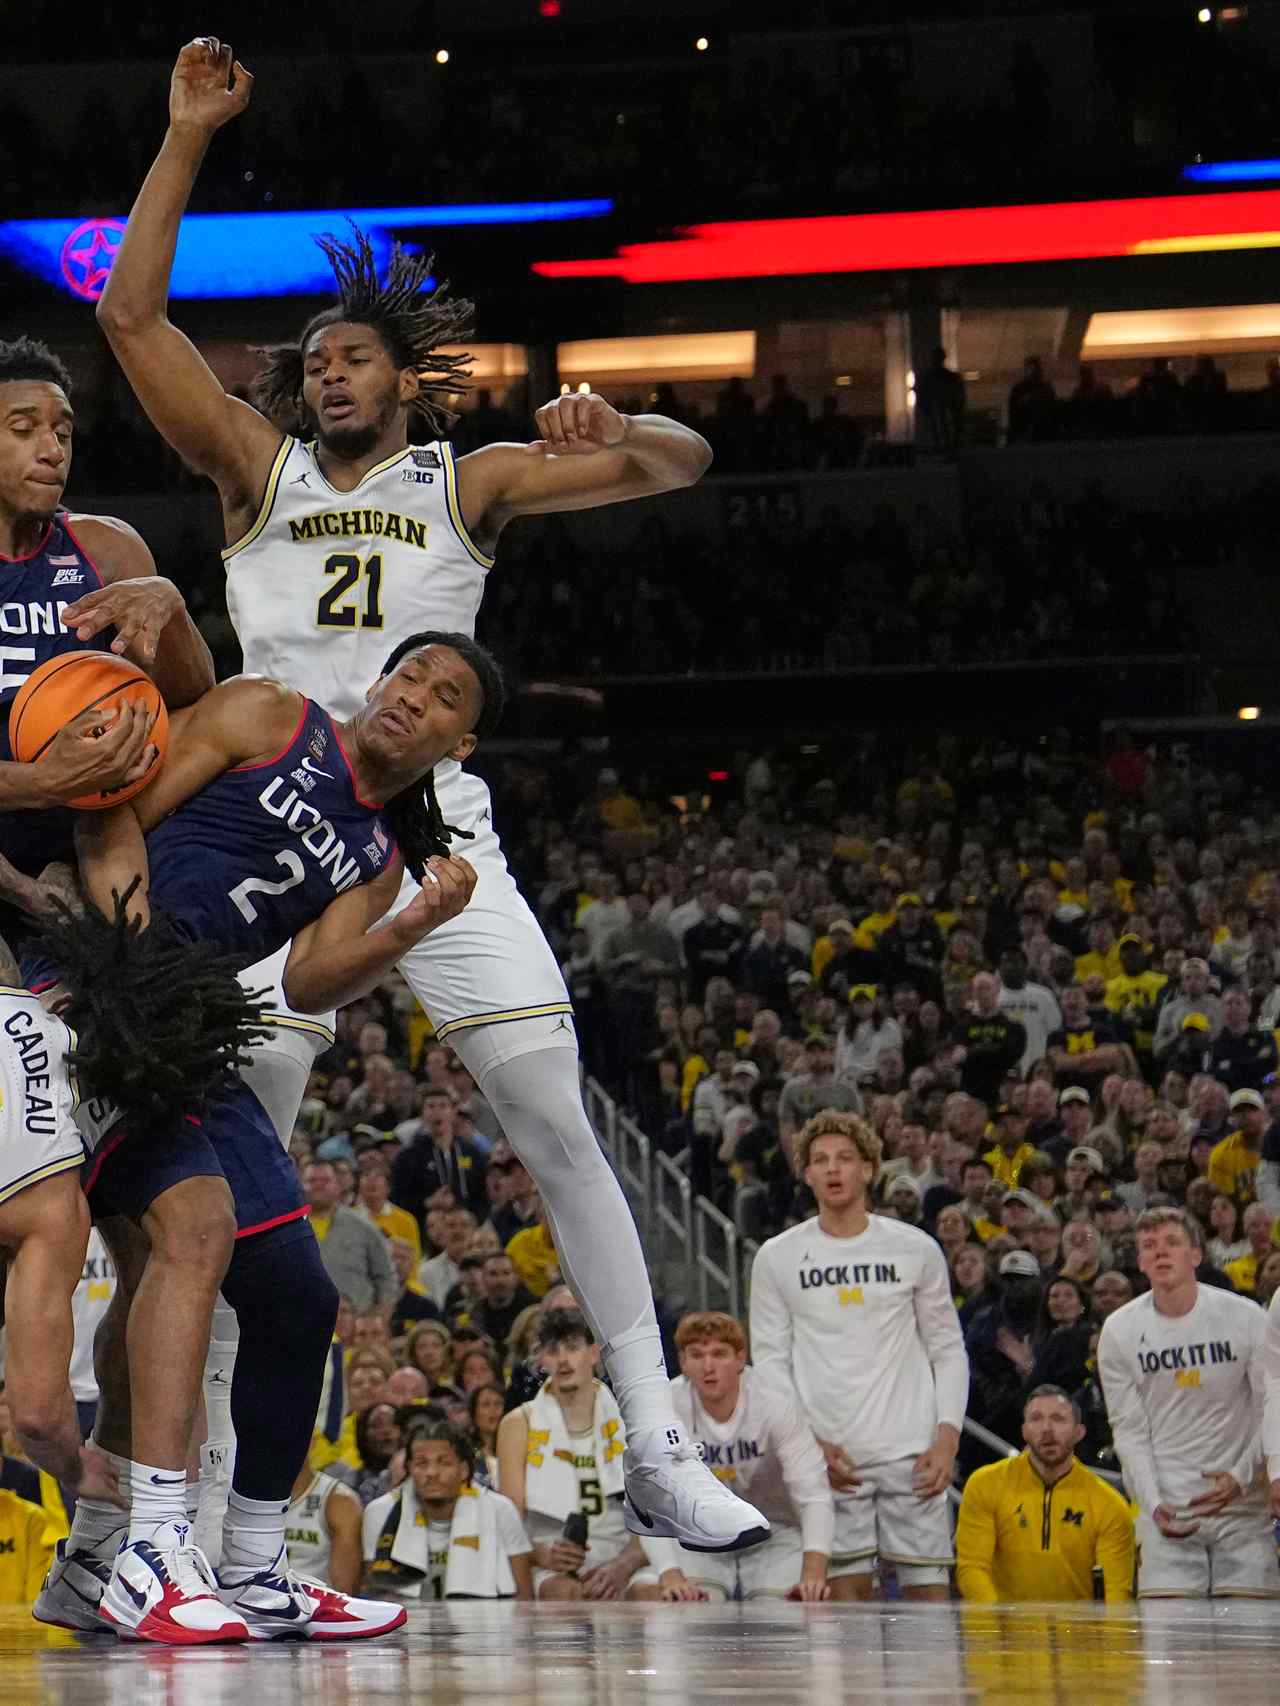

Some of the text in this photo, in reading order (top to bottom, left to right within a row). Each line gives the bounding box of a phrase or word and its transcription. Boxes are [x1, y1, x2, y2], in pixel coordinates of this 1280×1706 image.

[288, 508, 429, 549] MICHIGAN
[314, 551, 385, 631] 21
[228, 849, 305, 924] 2
[4, 1010, 56, 1135] CADEAU
[799, 1263, 901, 1289] LOCK IT IN.
[1137, 1341, 1238, 1373] LOCK IT IN.
[580, 1479, 604, 1516] 5
[1061, 1506, 1084, 1527] M
